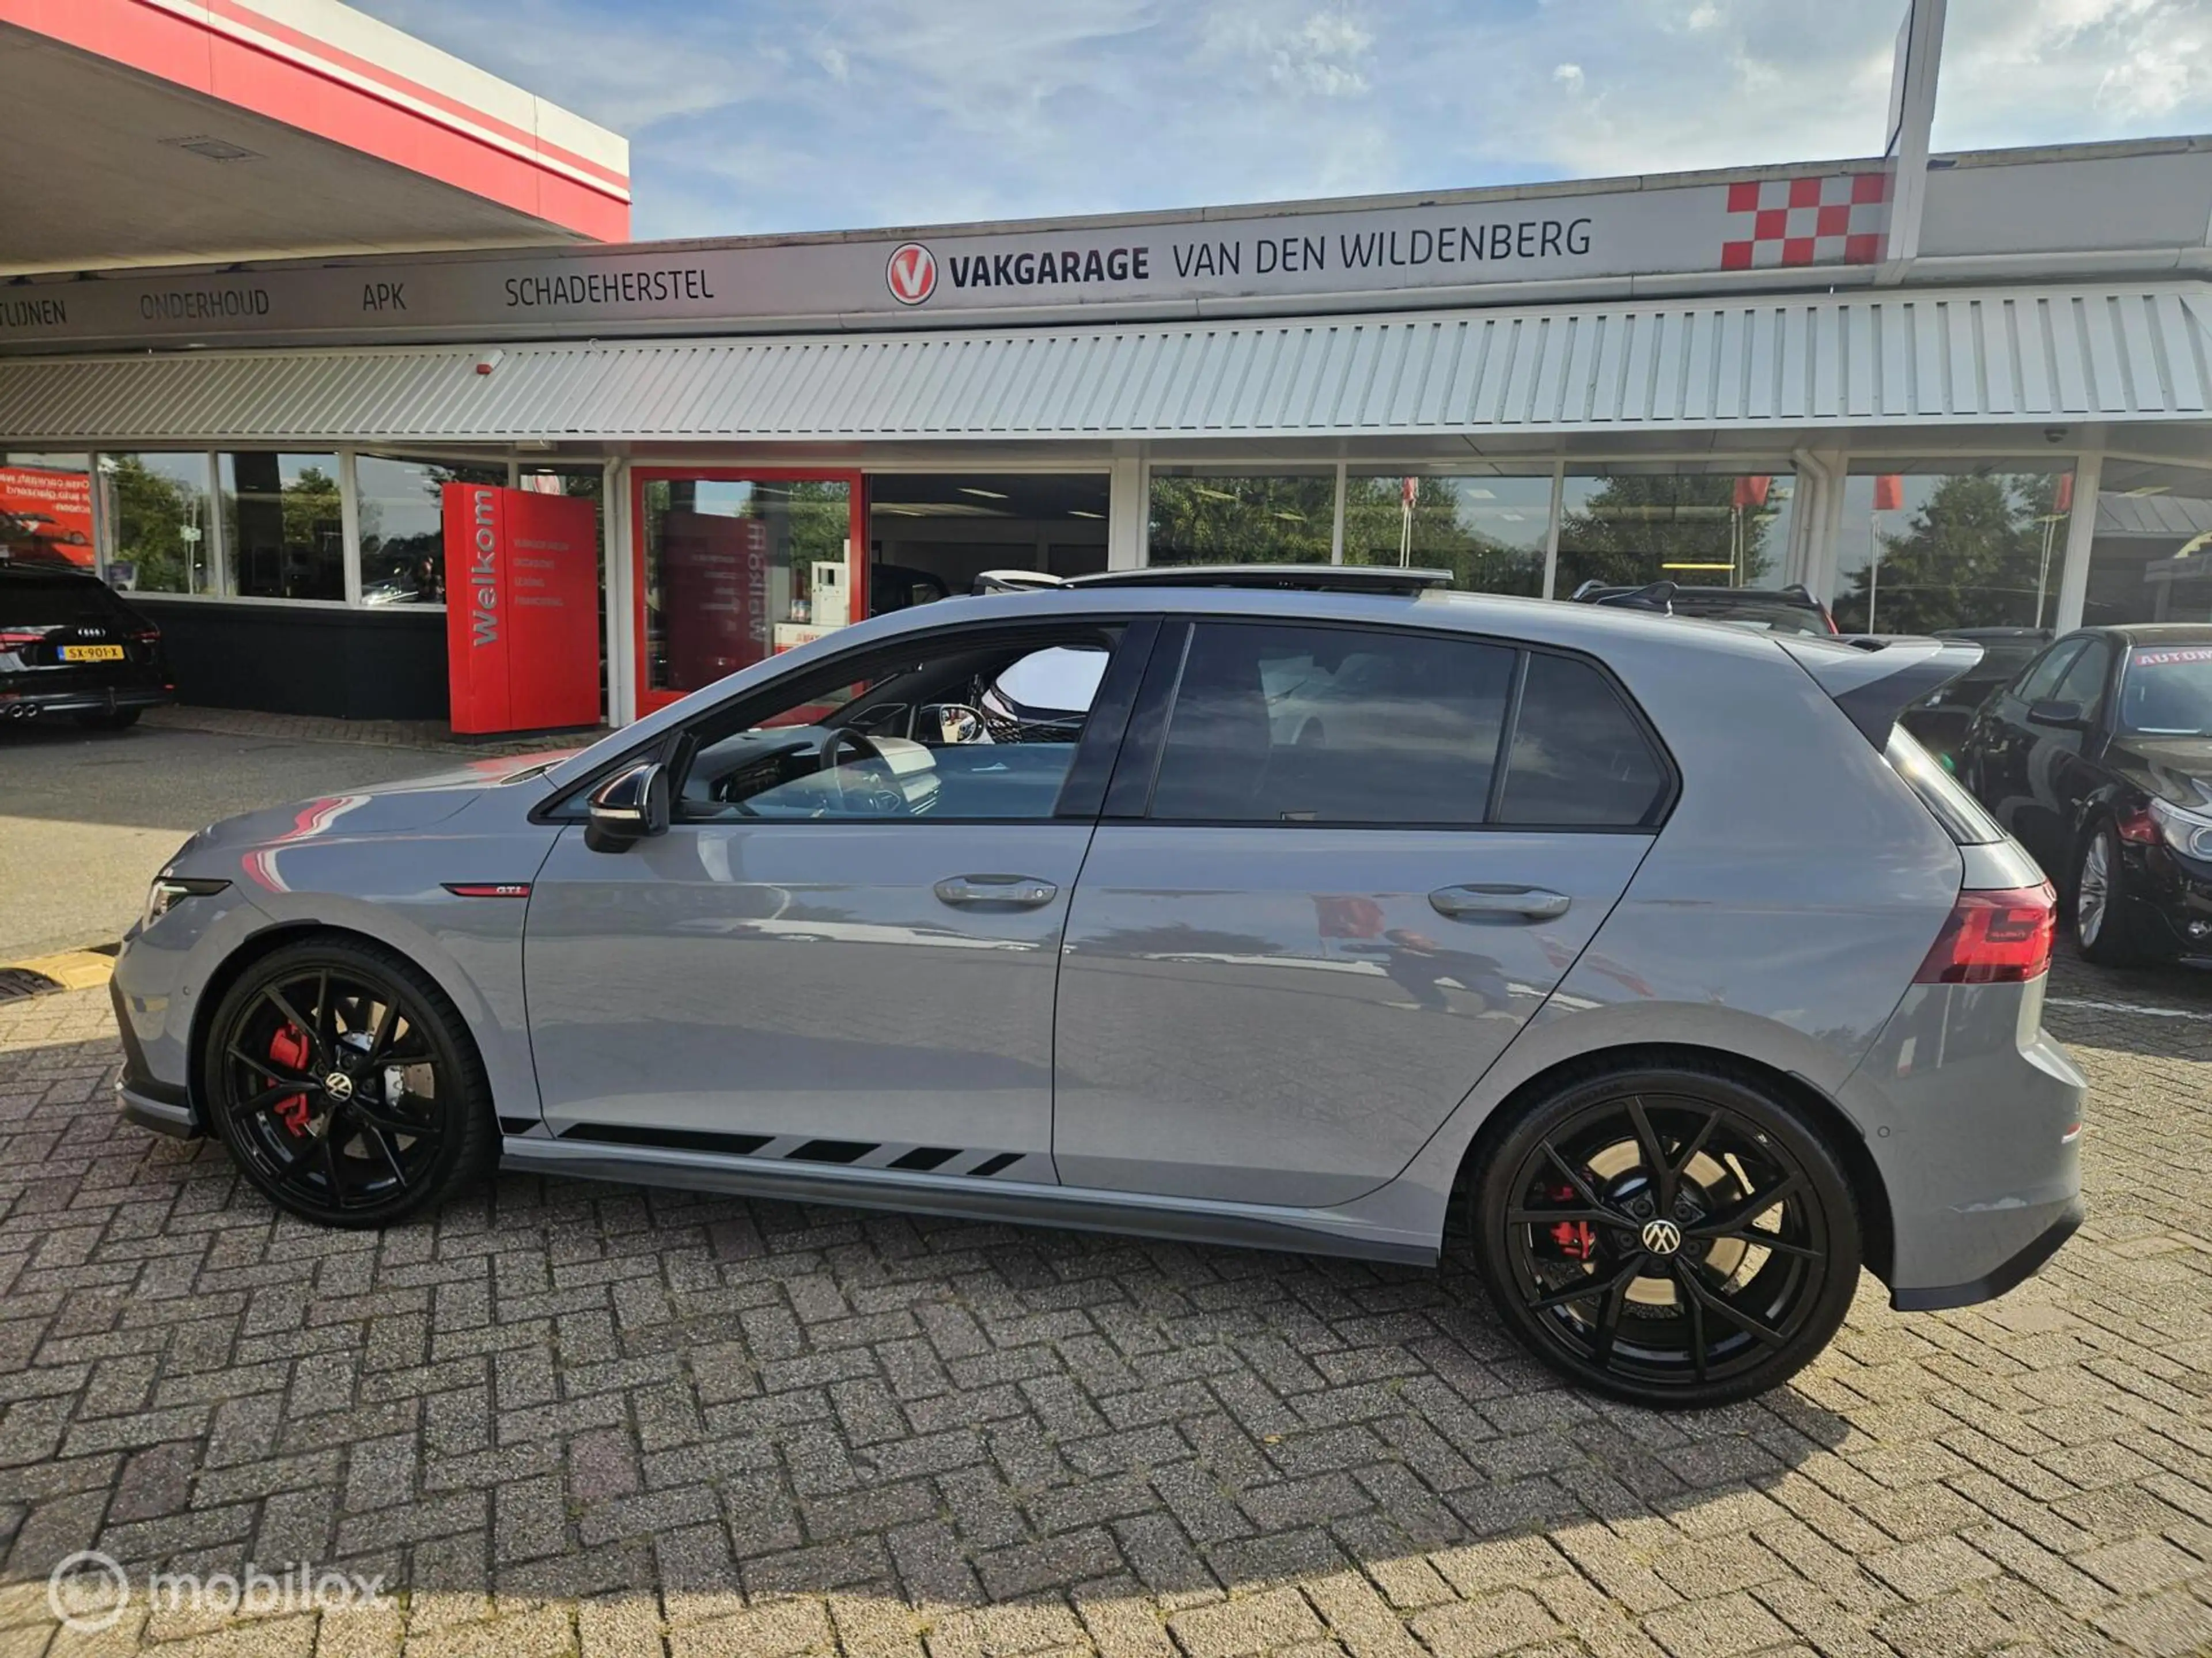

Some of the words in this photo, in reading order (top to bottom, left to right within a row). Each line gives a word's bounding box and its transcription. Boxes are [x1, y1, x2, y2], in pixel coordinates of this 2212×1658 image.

[949, 246, 1149, 287] VAKGARAGE
[1173, 241, 1240, 278] VAN
[1256, 235, 1325, 274] DEN
[1340, 218, 1592, 269] WILDENBERG
[362, 283, 407, 311] APK
[505, 269, 714, 306] SCHADEHERSTEL
[140, 289, 270, 320] ONDERHOUD
[471, 490, 498, 647] Welkom
[69, 647, 119, 659] SX-901-X
[497, 886, 522, 894] GTI
